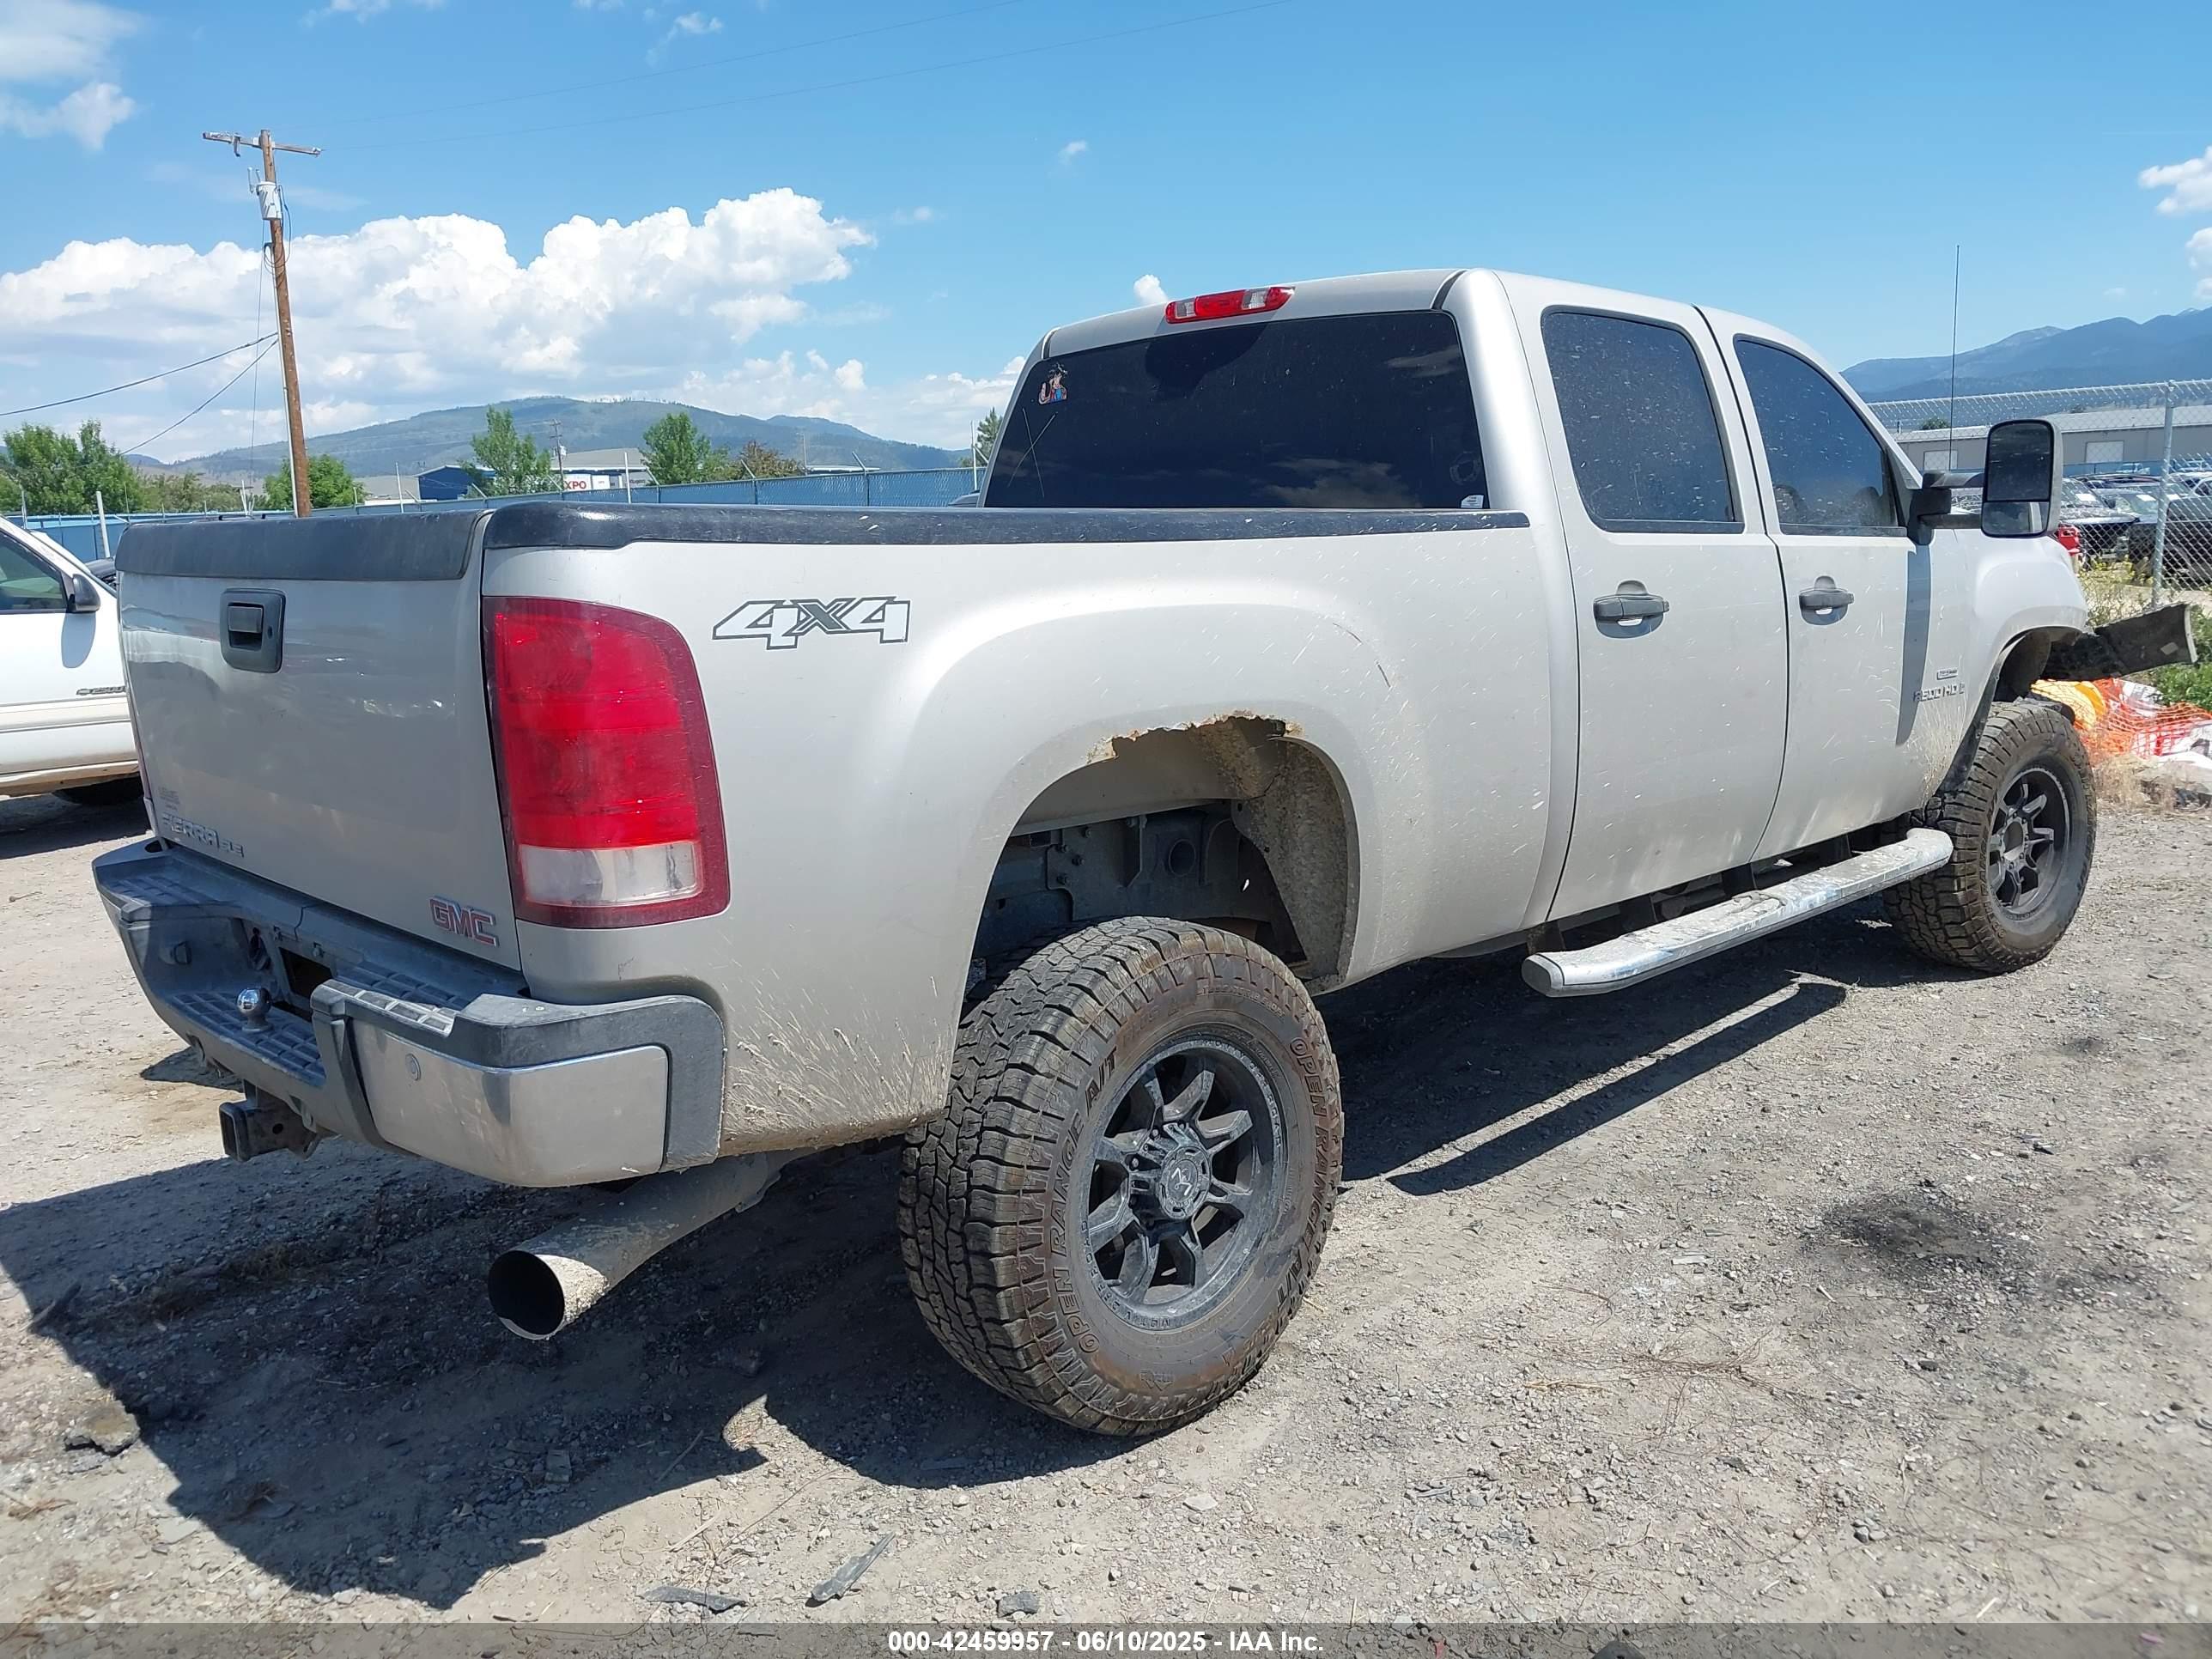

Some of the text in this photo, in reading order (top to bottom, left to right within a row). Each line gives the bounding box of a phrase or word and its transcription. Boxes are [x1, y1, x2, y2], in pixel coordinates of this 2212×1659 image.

[429, 896, 500, 946] GMC
[1290, 1036, 1327, 1117] OPEN
[1050, 1047, 1117, 1353] OPEN RANGE A/T
[1303, 1125, 1331, 1250] RANGE
